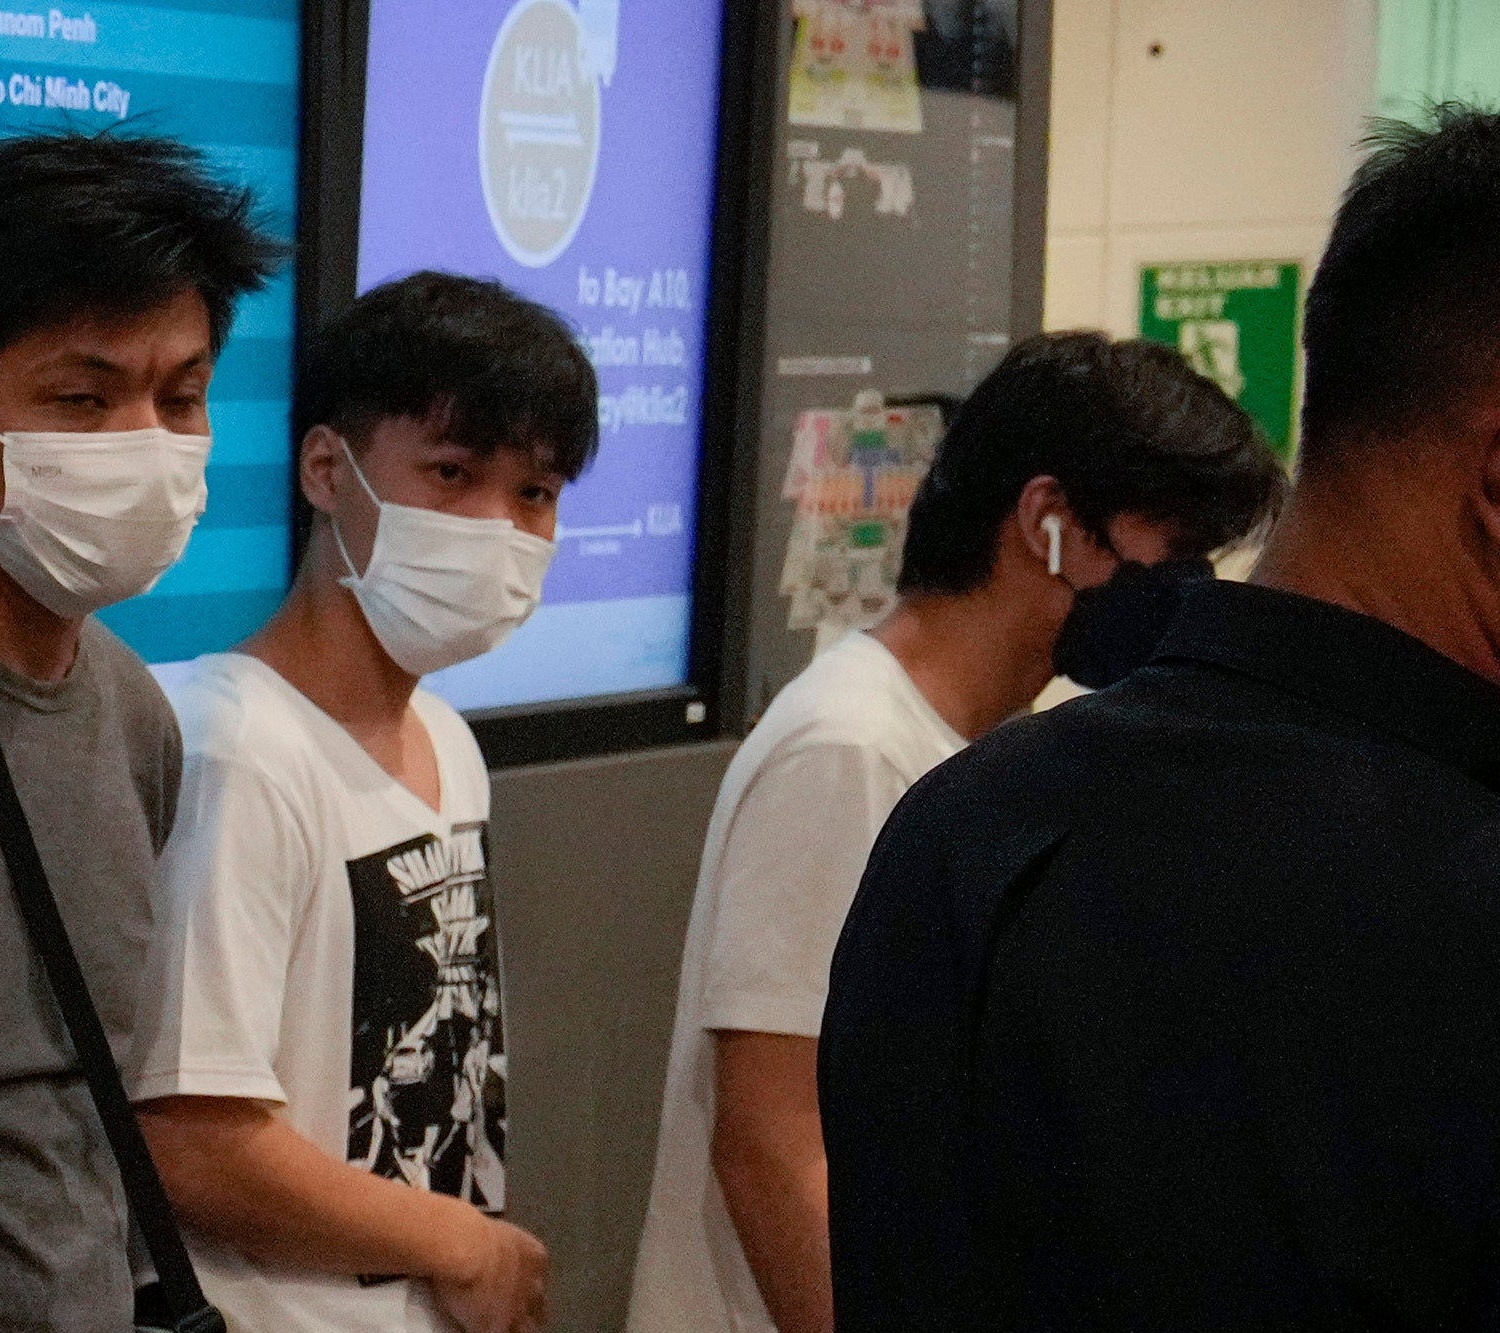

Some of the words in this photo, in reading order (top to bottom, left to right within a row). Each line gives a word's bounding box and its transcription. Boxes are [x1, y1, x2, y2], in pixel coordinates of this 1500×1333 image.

[48, 10, 97, 42] Penh
[8, 74, 43, 107] Chi
[44, 78, 90, 112] Minh
[93, 82, 131, 119] City
